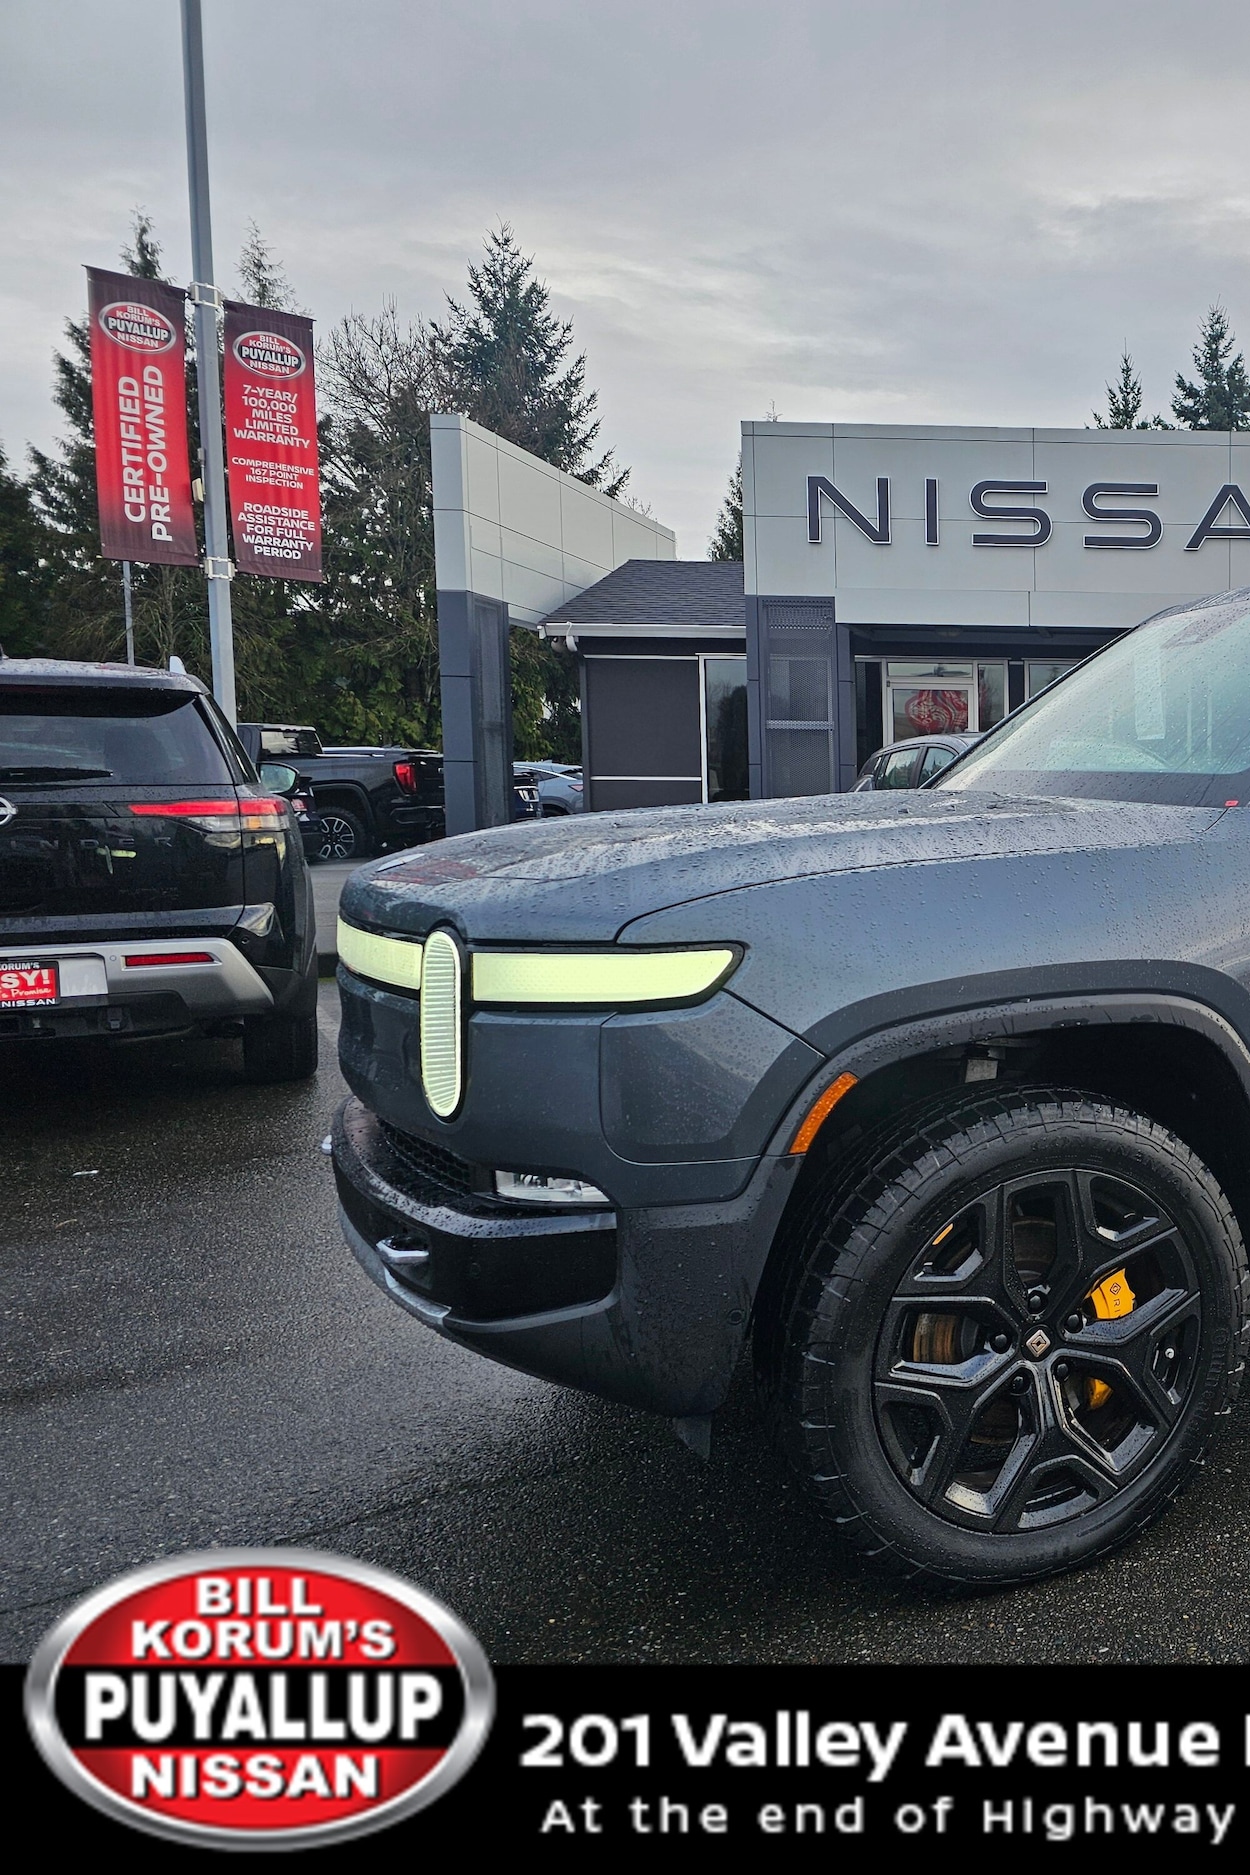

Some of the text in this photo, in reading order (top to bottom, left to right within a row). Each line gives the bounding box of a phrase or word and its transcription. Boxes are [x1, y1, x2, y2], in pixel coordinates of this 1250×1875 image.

[116, 310, 161, 327] KORUM'S
[126, 305, 149, 317] BILL
[107, 317, 169, 341] PUYALLUP
[117, 332, 159, 348] NISSAN
[249, 340, 291, 354] KORUM'S
[259, 335, 280, 345] BILL
[242, 346, 299, 367] PUYALLUP
[249, 360, 290, 374] NISSAN
[243, 384, 298, 403] 7-YEAR/
[242, 396, 297, 414] 100,000
[252, 408, 292, 424] MILES
[245, 418, 299, 436] LIMITED
[233, 428, 310, 449] WARRANTY
[118, 376, 146, 523] CERTIFIED
[143, 365, 173, 541] PRE-OWNED
[231, 457, 315, 476] COMPREHENSIVE
[250, 468, 299, 481] 167 POINT
[245, 475, 303, 489] INSPECTION
[243, 502, 309, 520] ROADSIDE
[237, 512, 315, 531] ASSISTANCE
[246, 524, 307, 540] FOR FULL
[242, 533, 313, 551] WARRANTY
[254, 545, 302, 560] PERIOD
[1, 998, 56, 1008] NISSAN
